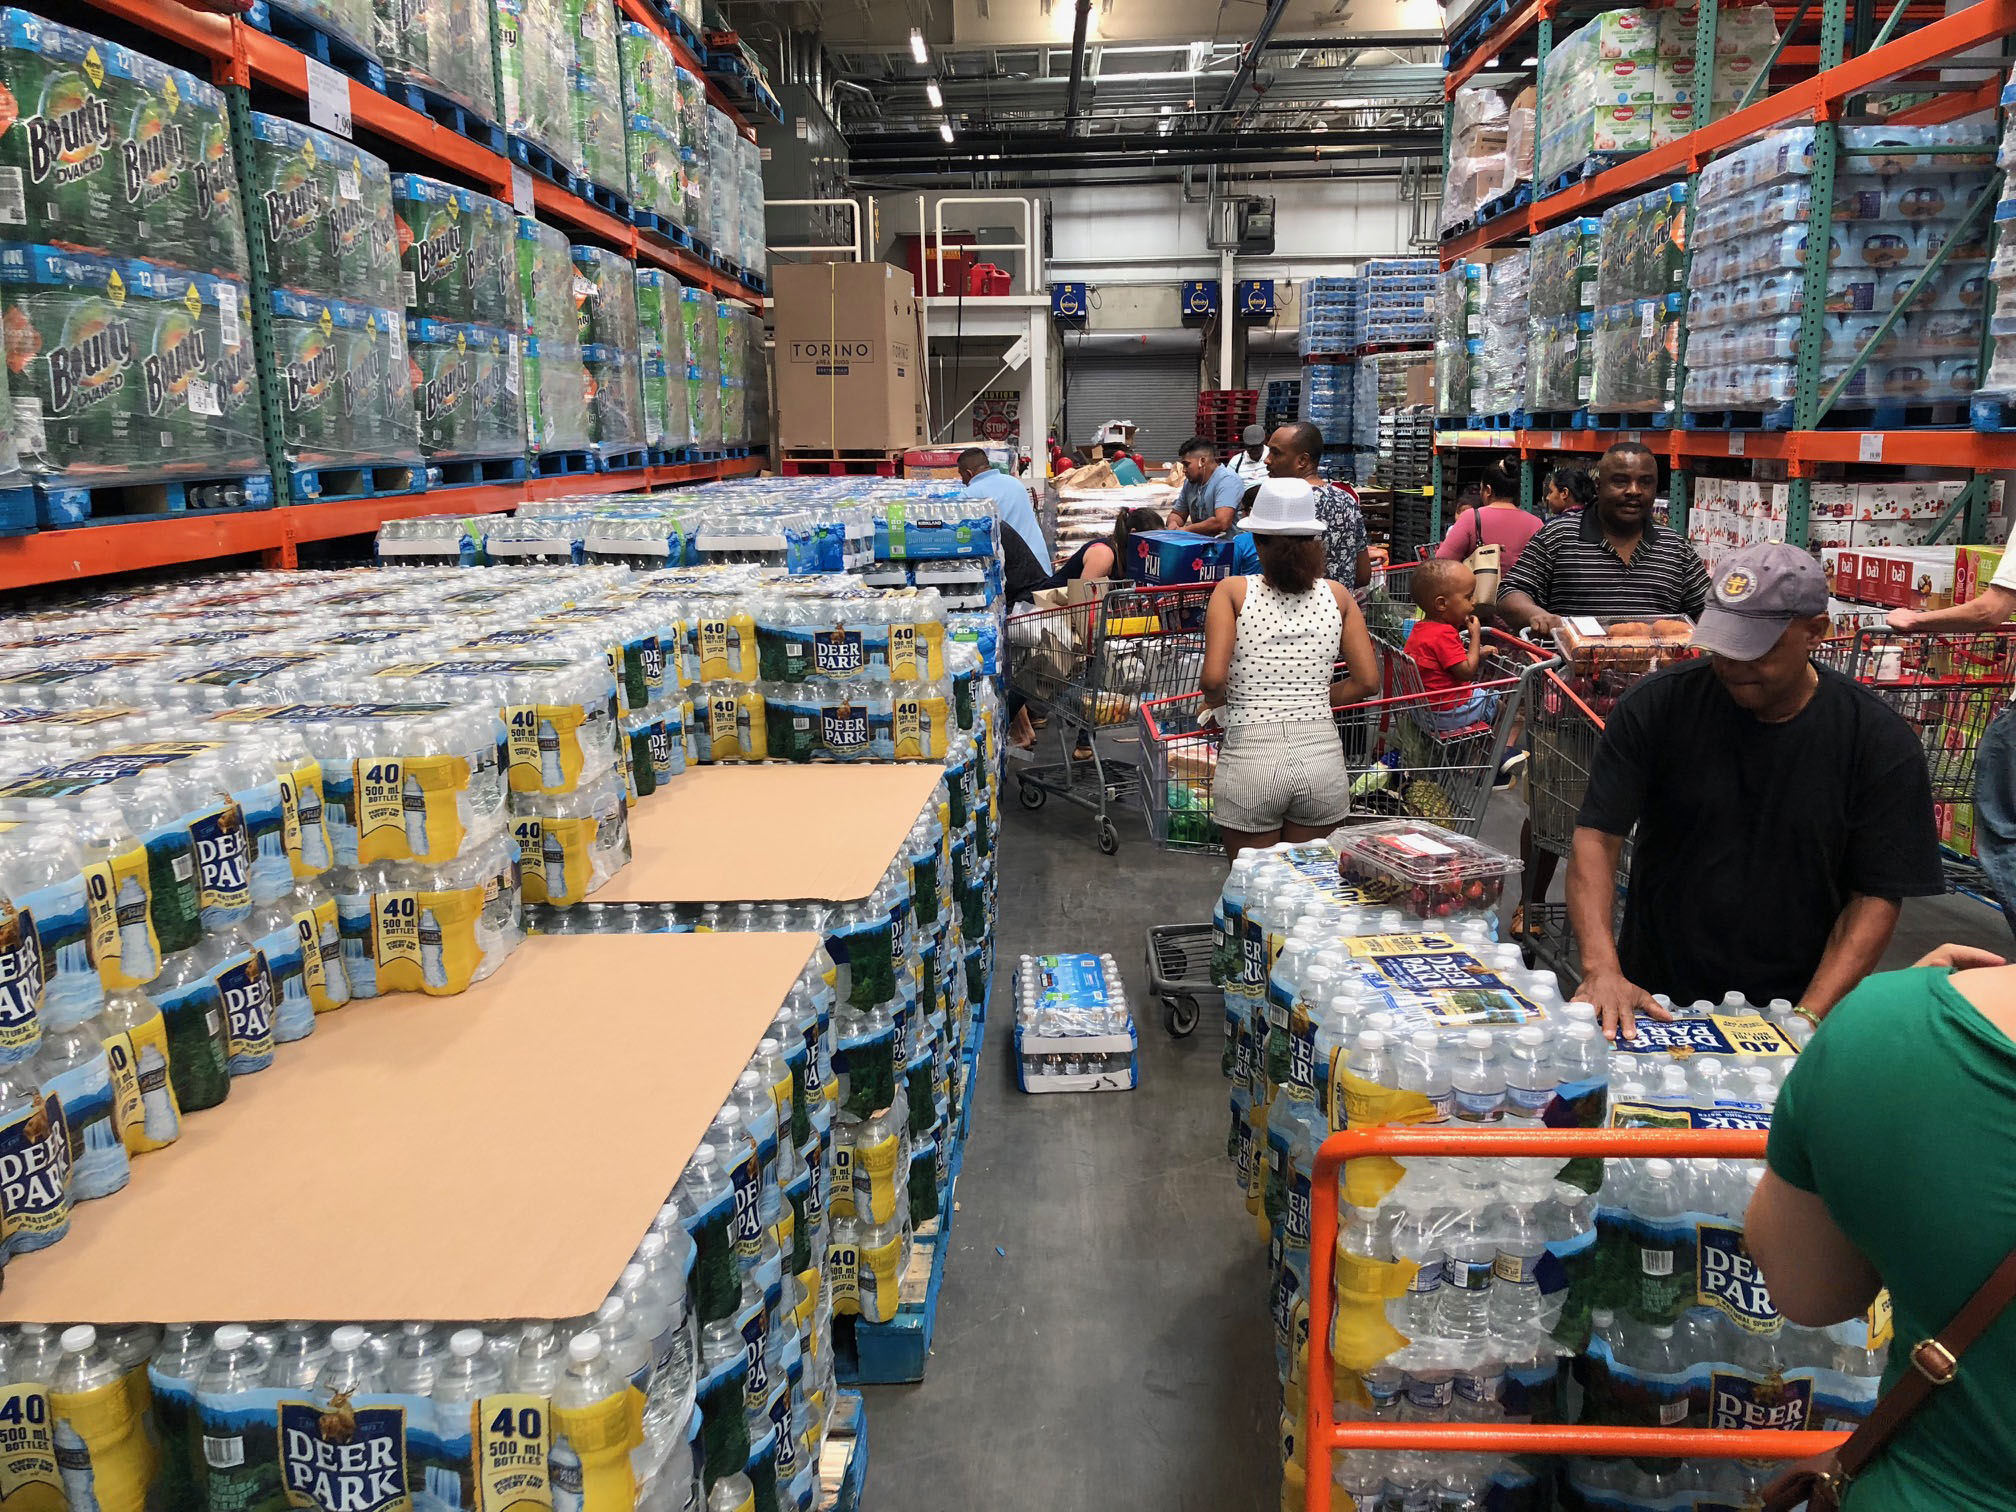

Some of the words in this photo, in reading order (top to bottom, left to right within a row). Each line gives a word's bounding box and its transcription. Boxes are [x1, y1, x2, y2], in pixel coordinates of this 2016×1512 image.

[25, 93, 112, 184] Bounty
[417, 225, 462, 282] Bounty
[139, 271, 151, 287] 12
[793, 344, 868, 356] TORINO
[986, 422, 1007, 433] STOP
[1144, 555, 1160, 576] FIJI
[1200, 564, 1215, 580] FIJI
[704, 623, 724, 634] 40
[894, 629, 913, 639] 40
[644, 650, 661, 663] DE
[817, 642, 860, 656] DEER
[647, 664, 662, 676] PA
[818, 655, 862, 669] PARK
[715, 701, 734, 712] 40
[898, 703, 917, 714] 40
[512, 711, 534, 727] 40
[824, 716, 866, 731] DEER
[652, 734, 667, 747] DE
[825, 730, 867, 744] PARK
[654, 747, 668, 760] PA
[366, 764, 399, 784] 40
[365, 786, 383, 796] 500
[388, 785, 400, 794] mL
[368, 795, 399, 803] BOTTLES
[515, 822, 540, 838] 40
[197, 825, 247, 864] DE
[202, 855, 249, 887] PA
[383, 898, 415, 917] 40
[382, 919, 402, 928] 500
[404, 918, 416, 927] mL
[1243, 938, 1262, 962] ER
[0, 936, 38, 984] EER
[1244, 961, 1264, 981] RK
[1423, 954, 1482, 986] DEER
[0, 964, 42, 1021] ARK
[1631, 1035, 1722, 1047] DEER
[1740, 1041, 1781, 1052] 40
[735, 1175, 761, 1215] DE
[1289, 1191, 1308, 1214] ER
[738, 1200, 760, 1238] PA
[1287, 1212, 1308, 1238] RK
[830, 1250, 855, 1266] 40
[1706, 1271, 1778, 1314] PAR
[747, 1331, 767, 1368] DE
[749, 1360, 768, 1389] PA
[0, 1394, 45, 1425] 40
[1718, 1391, 1803, 1426] DEER
[491, 1408, 541, 1439] 40
[0, 1427, 27, 1443] 500
[33, 1427, 50, 1441] mL
[5, 1440, 49, 1452] BOTTLES
[287, 1427, 398, 1472] DEER
[489, 1441, 517, 1456] 500
[525, 1443, 544, 1457] mL
[494, 1455, 542, 1468] BOTTLES
[289, 1468, 402, 1512] PARK
